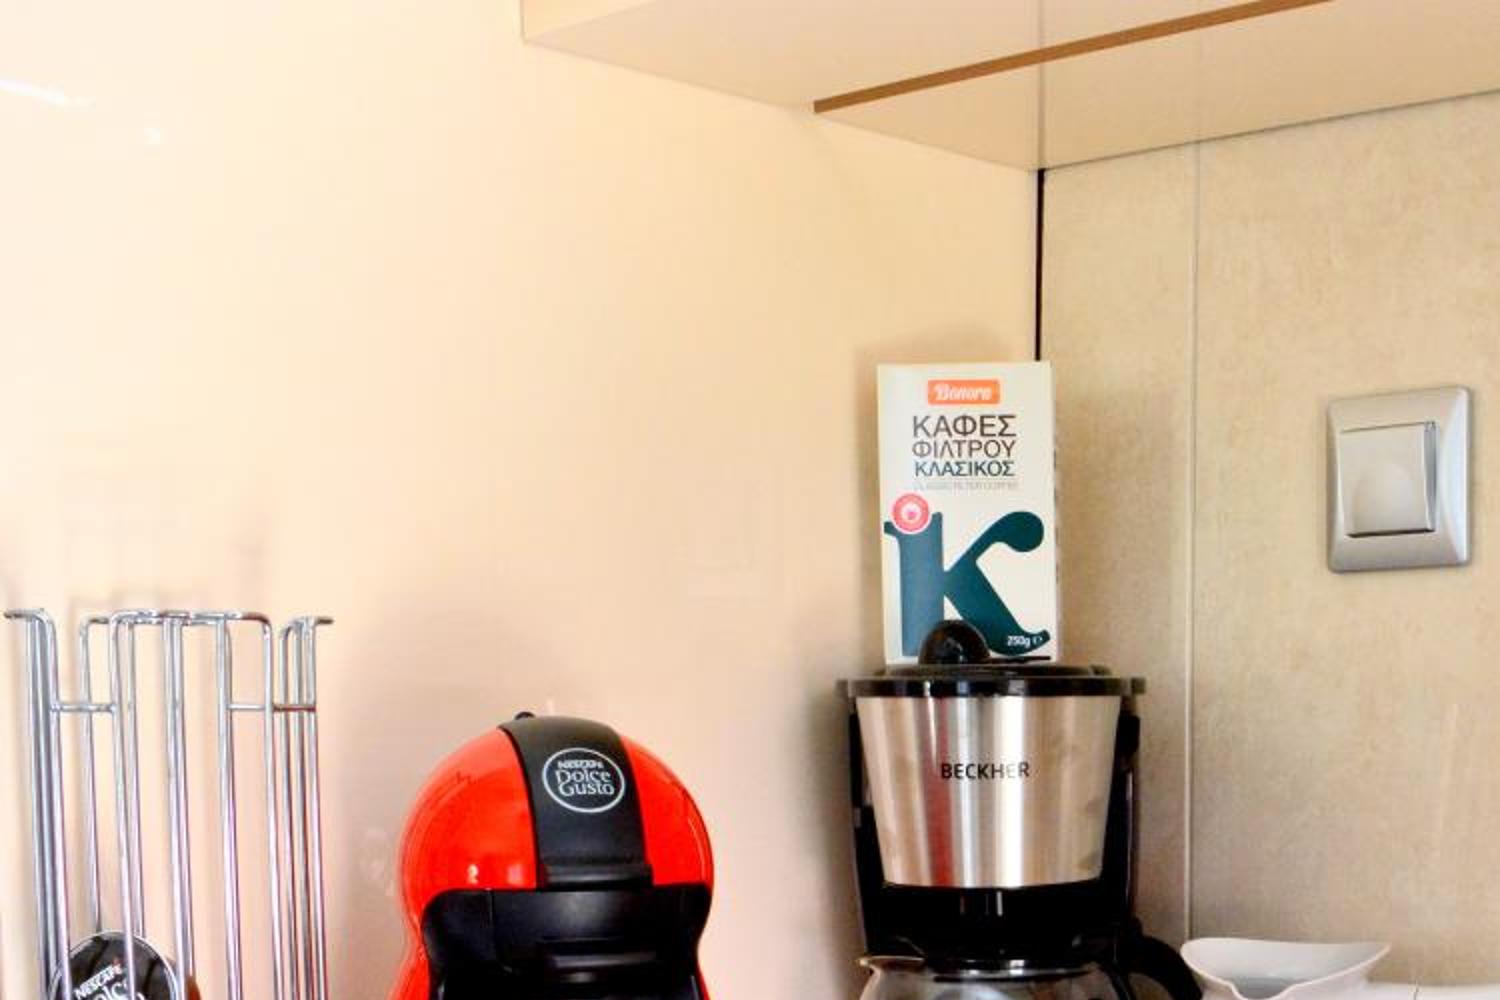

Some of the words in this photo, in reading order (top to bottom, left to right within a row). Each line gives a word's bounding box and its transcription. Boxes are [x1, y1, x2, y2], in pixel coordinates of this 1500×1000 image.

[912, 413, 1017, 438] ΚΑΦΕΣ
[912, 439, 1016, 459] ΦΙΛΤΡΟΥ
[914, 460, 1016, 477] ΚΛΑΣΙΚΟΣ
[555, 769, 611, 784] Dolce
[941, 761, 1030, 780] BECKHER
[558, 782, 615, 797] Gusto
